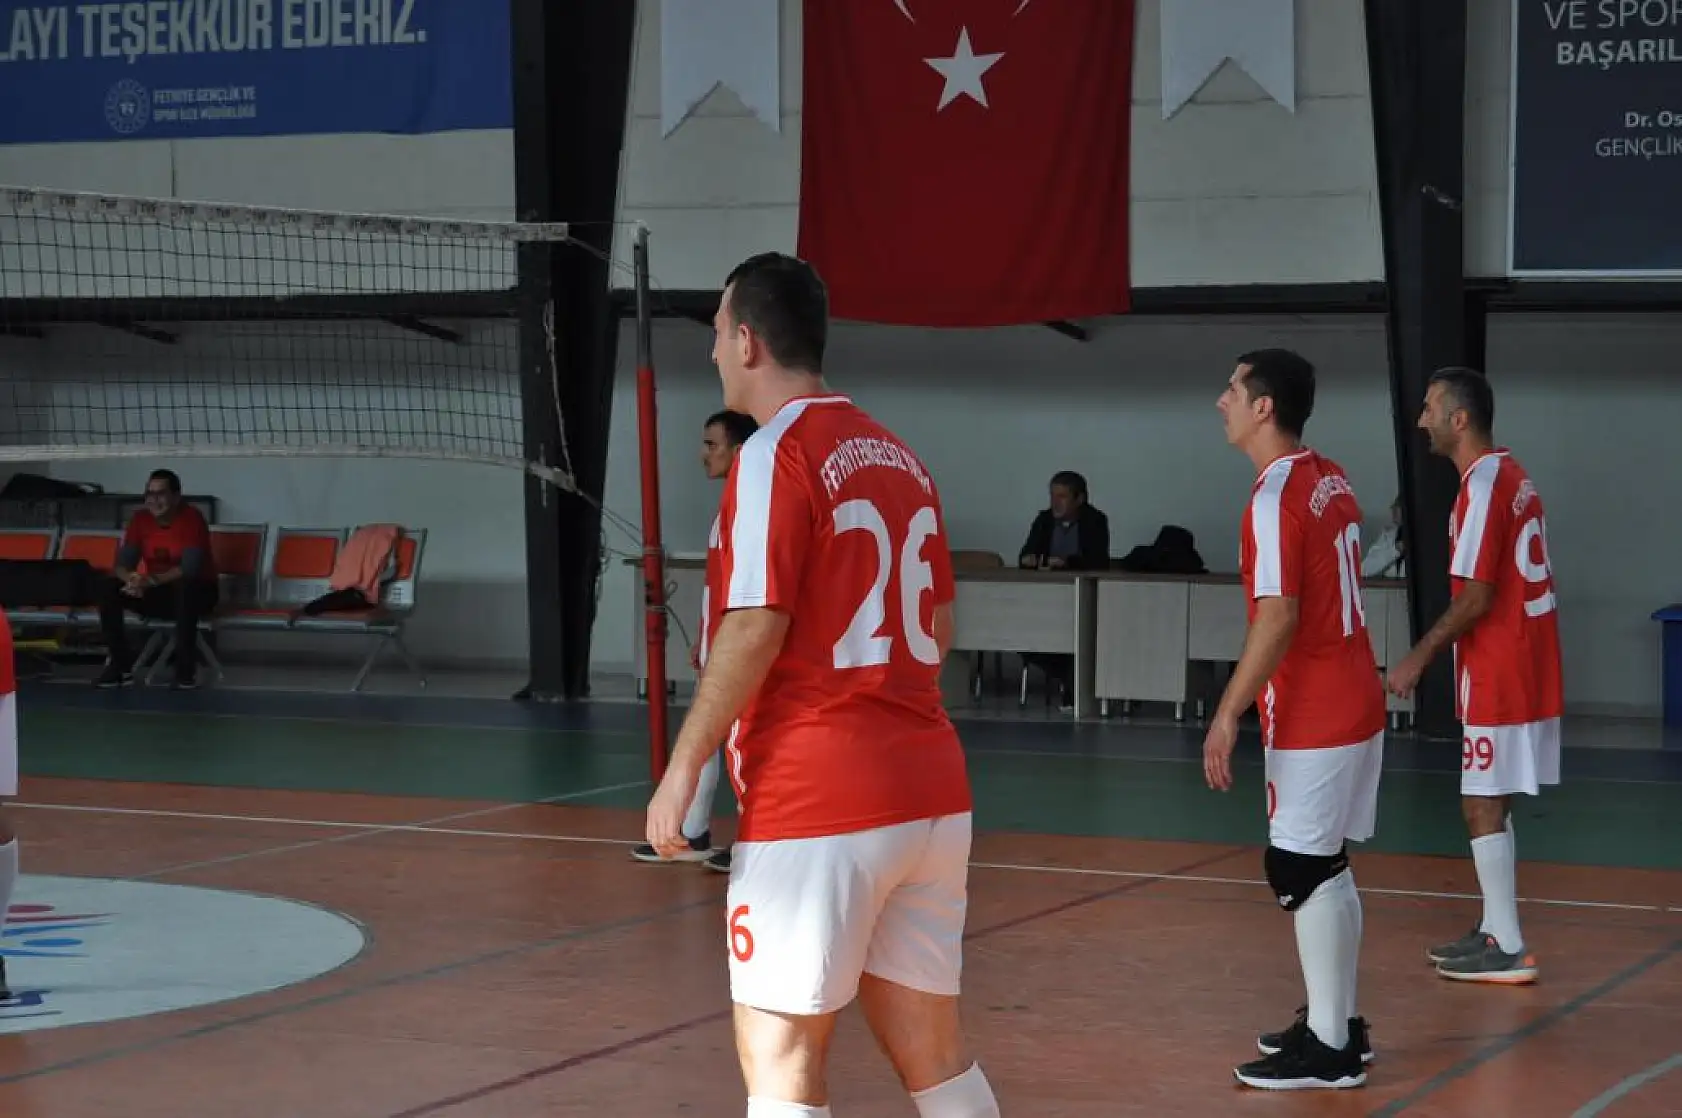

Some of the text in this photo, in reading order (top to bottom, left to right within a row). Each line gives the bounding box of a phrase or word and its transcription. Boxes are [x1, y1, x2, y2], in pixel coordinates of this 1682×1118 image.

[0, 6, 68, 62] AYI
[1544, 1, 1587, 29] VE
[1557, 38, 1682, 70] BAŞARIL
[1625, 111, 1653, 128] Dr.
[832, 498, 940, 669] 26
[730, 904, 754, 963] 6
